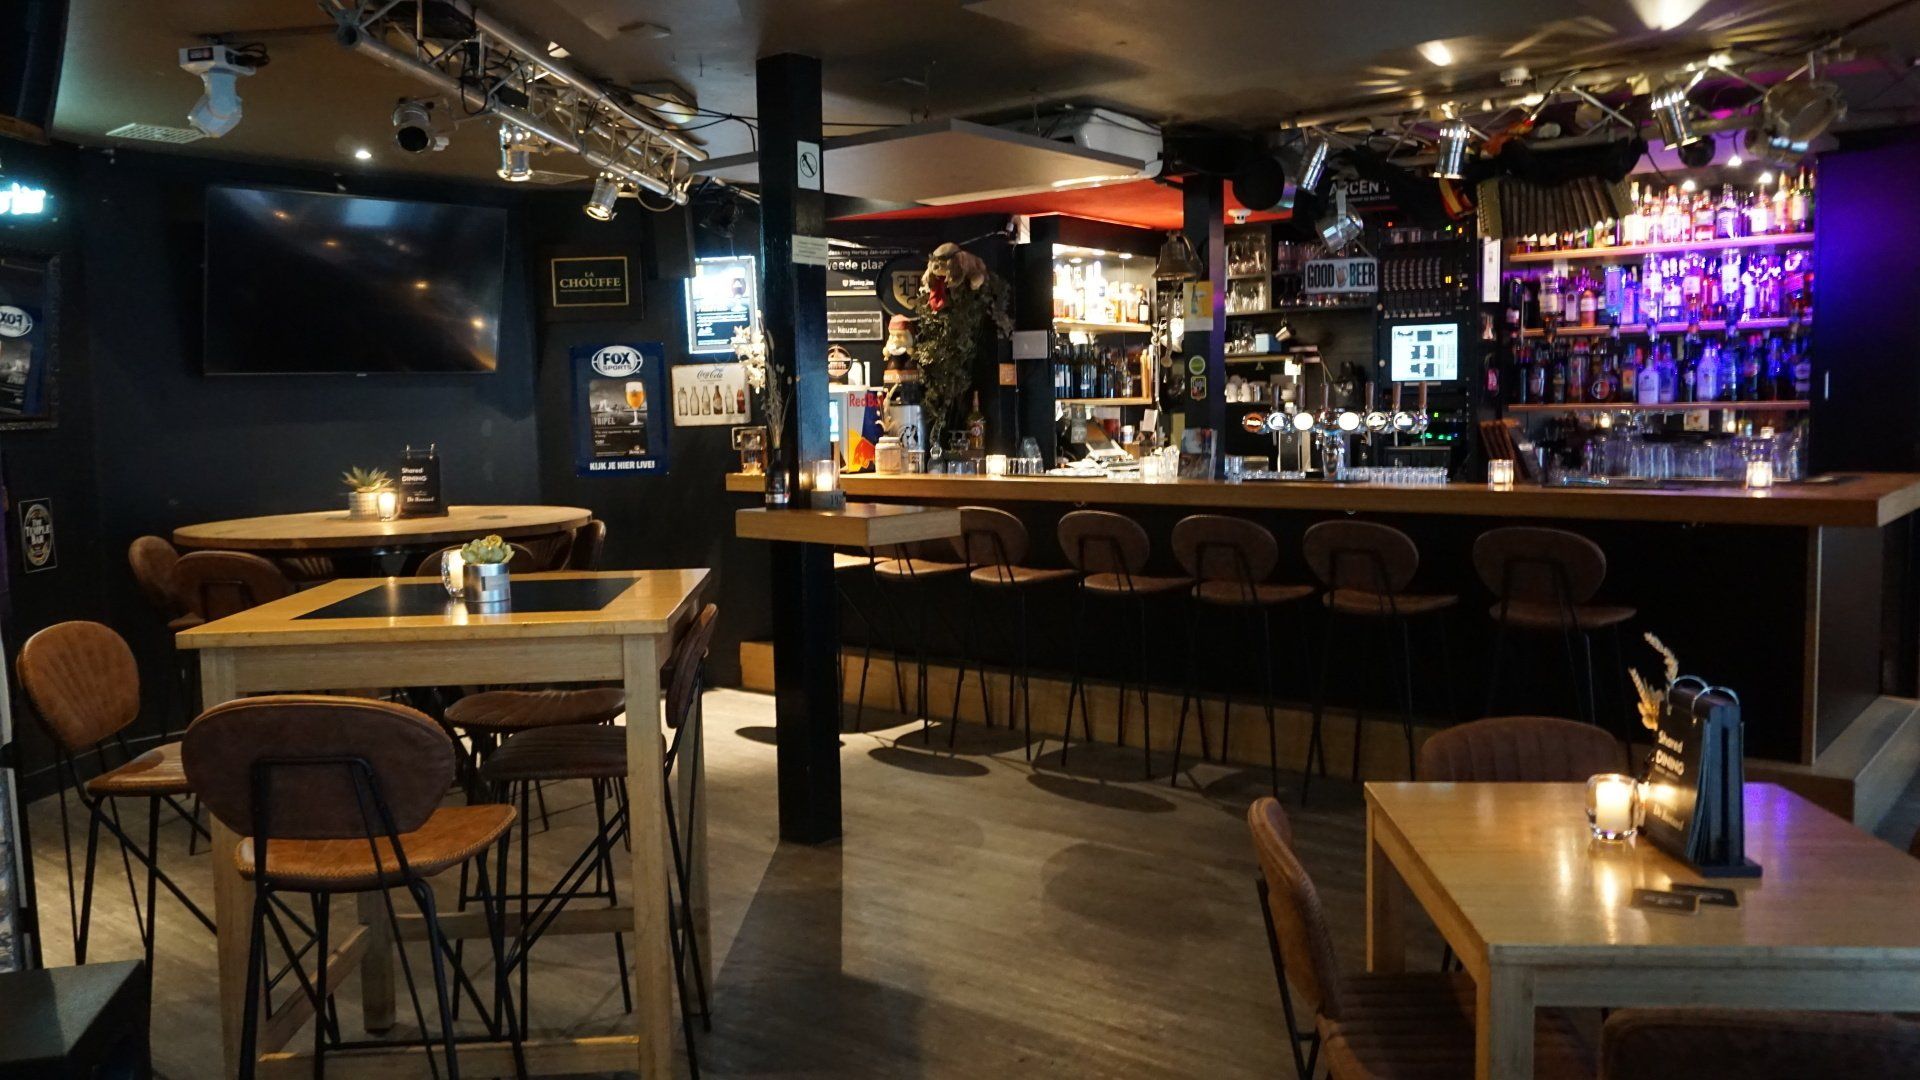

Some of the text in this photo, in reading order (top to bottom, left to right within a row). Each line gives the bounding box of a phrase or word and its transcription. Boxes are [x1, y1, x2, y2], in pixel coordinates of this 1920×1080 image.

[1307, 262, 1375, 288] GOOD BEER
[560, 277, 621, 288] CHOUFFE
[602, 352, 631, 365] FOX
[849, 393, 866, 407] Red
[594, 417, 616, 426] TRIPEL
[589, 460, 655, 471] KIJK JE HIER LIVE!
[1658, 729, 1684, 754] Shared
[1655, 749, 1685, 776] DINING
